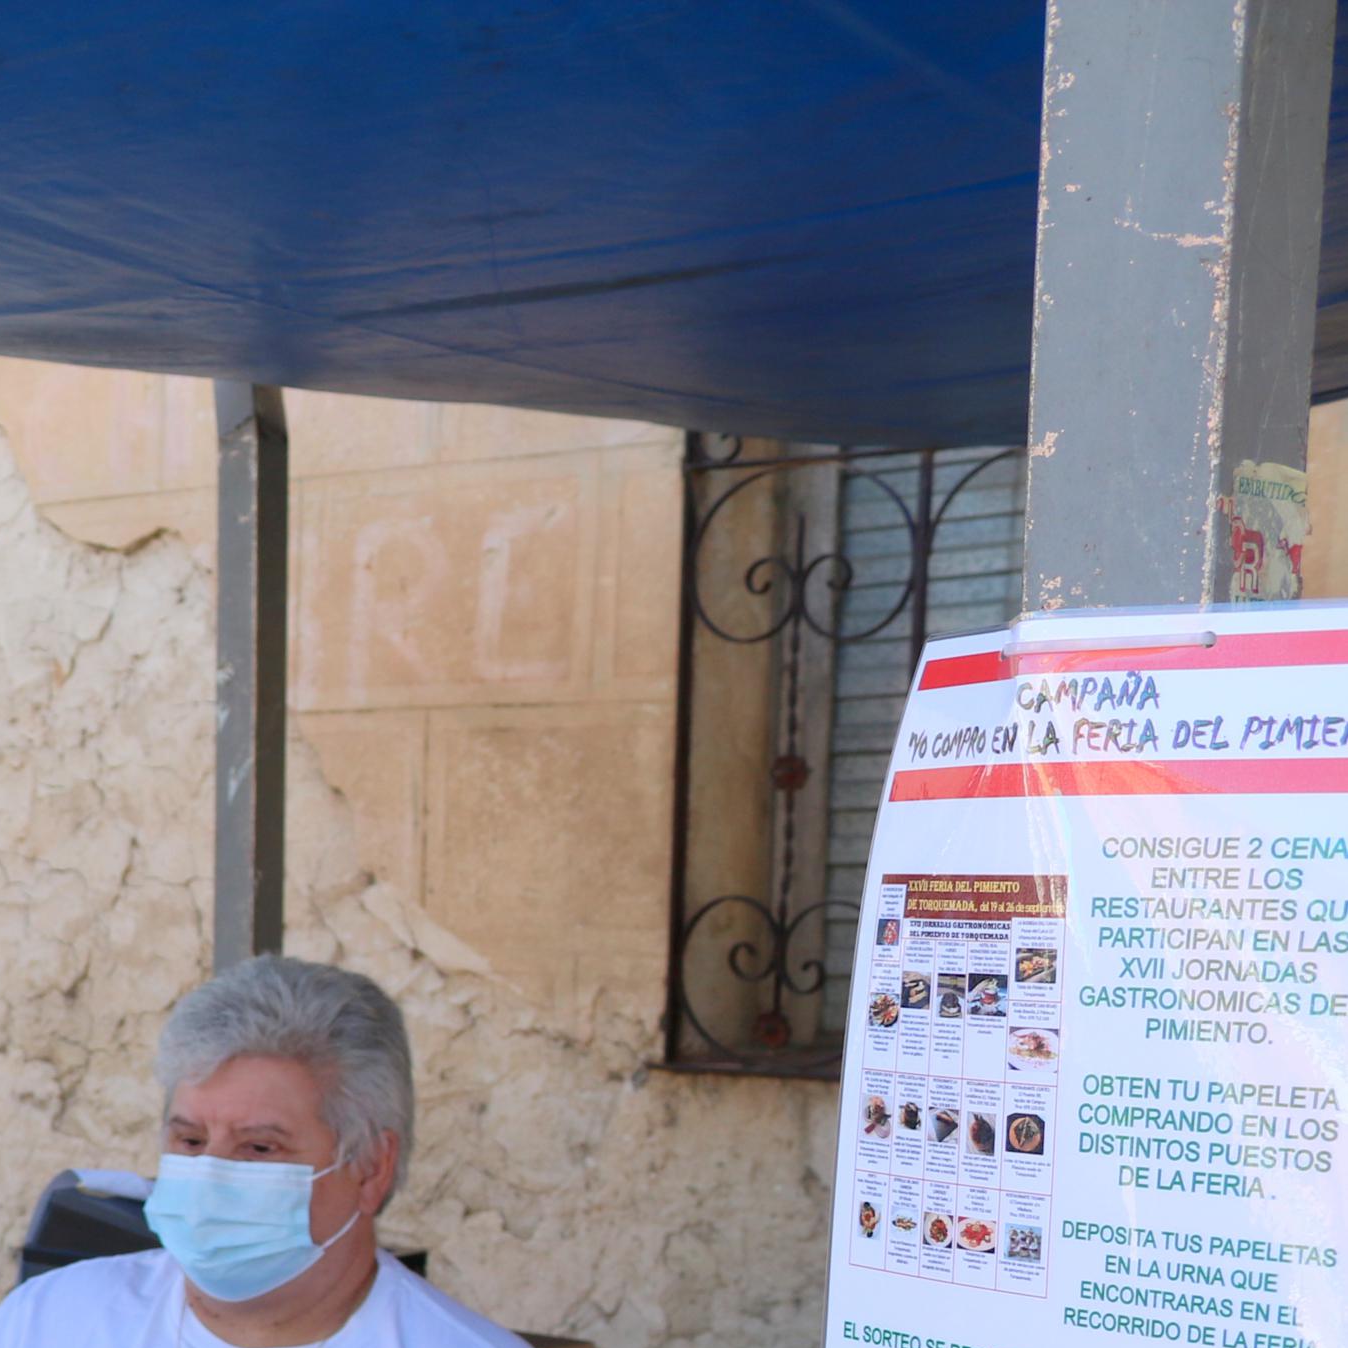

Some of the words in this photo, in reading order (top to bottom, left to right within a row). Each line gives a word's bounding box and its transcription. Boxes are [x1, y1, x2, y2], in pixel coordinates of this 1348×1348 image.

[1017, 671, 1160, 713] CAMPAÑA
[931, 726, 987, 760] COMPRO
[992, 722, 1019, 754] EN
[1027, 720, 1060, 756] LA
[1072, 718, 1159, 754] FERIA
[1172, 715, 1230, 751] DEL
[1102, 836, 1240, 859] CONSIGUE
[1246, 837, 1262, 859] 2
[929, 881, 954, 893] FERIA
[955, 881, 972, 893] DEL
[974, 881, 1021, 894] PIMIENTO
[1151, 867, 1240, 889] ENTRE
[1248, 868, 1304, 890] LOS
[1091, 897, 1298, 921] RESTAURANTES
[961, 932, 1009, 940] TORQUEMADA
[1098, 926, 1244, 951] PARTICIPAN
[1252, 930, 1290, 951] EN
[1298, 930, 1348, 953] LAS
[1119, 957, 1164, 980] XVII
[1172, 958, 1319, 984] JORNADAS
[1079, 985, 1301, 1015] GASTRONOMICAS
[1145, 1018, 1273, 1045] PIMIENTO.
[1082, 1074, 1161, 1099] OBTEN
[1167, 1079, 1200, 1102] TU
[1207, 1081, 1340, 1111] PAPELETA
[1078, 1103, 1233, 1135] COMPRANDO
[1241, 1114, 1277, 1138] EN
[1285, 1117, 1339, 1142] LOS
[1078, 1131, 1200, 1163] DISTINTOS
[1208, 1142, 1333, 1173] PUESTOS
[1118, 1164, 1150, 1188] DE
[1156, 1168, 1186, 1192] LA
[1062, 1220, 1157, 1249] DEPOSITA
[1162, 1231, 1203, 1254] TUS
[1209, 1236, 1338, 1268] PAPELETAS
[1105, 1253, 1131, 1276] EN
[1137, 1258, 1161, 1279] LA
[1166, 1262, 1225, 1287] URNA
[1230, 1269, 1278, 1293] QUE
[1080, 1280, 1233, 1318] ENCONTRARAS
[1240, 1301, 1270, 1323] EN
[1277, 1305, 1304, 1327] EL
[843, 1321, 859, 1341] EL
[1063, 1306, 1181, 1341] RECORRIDO
[1187, 1324, 1216, 1346] DE
